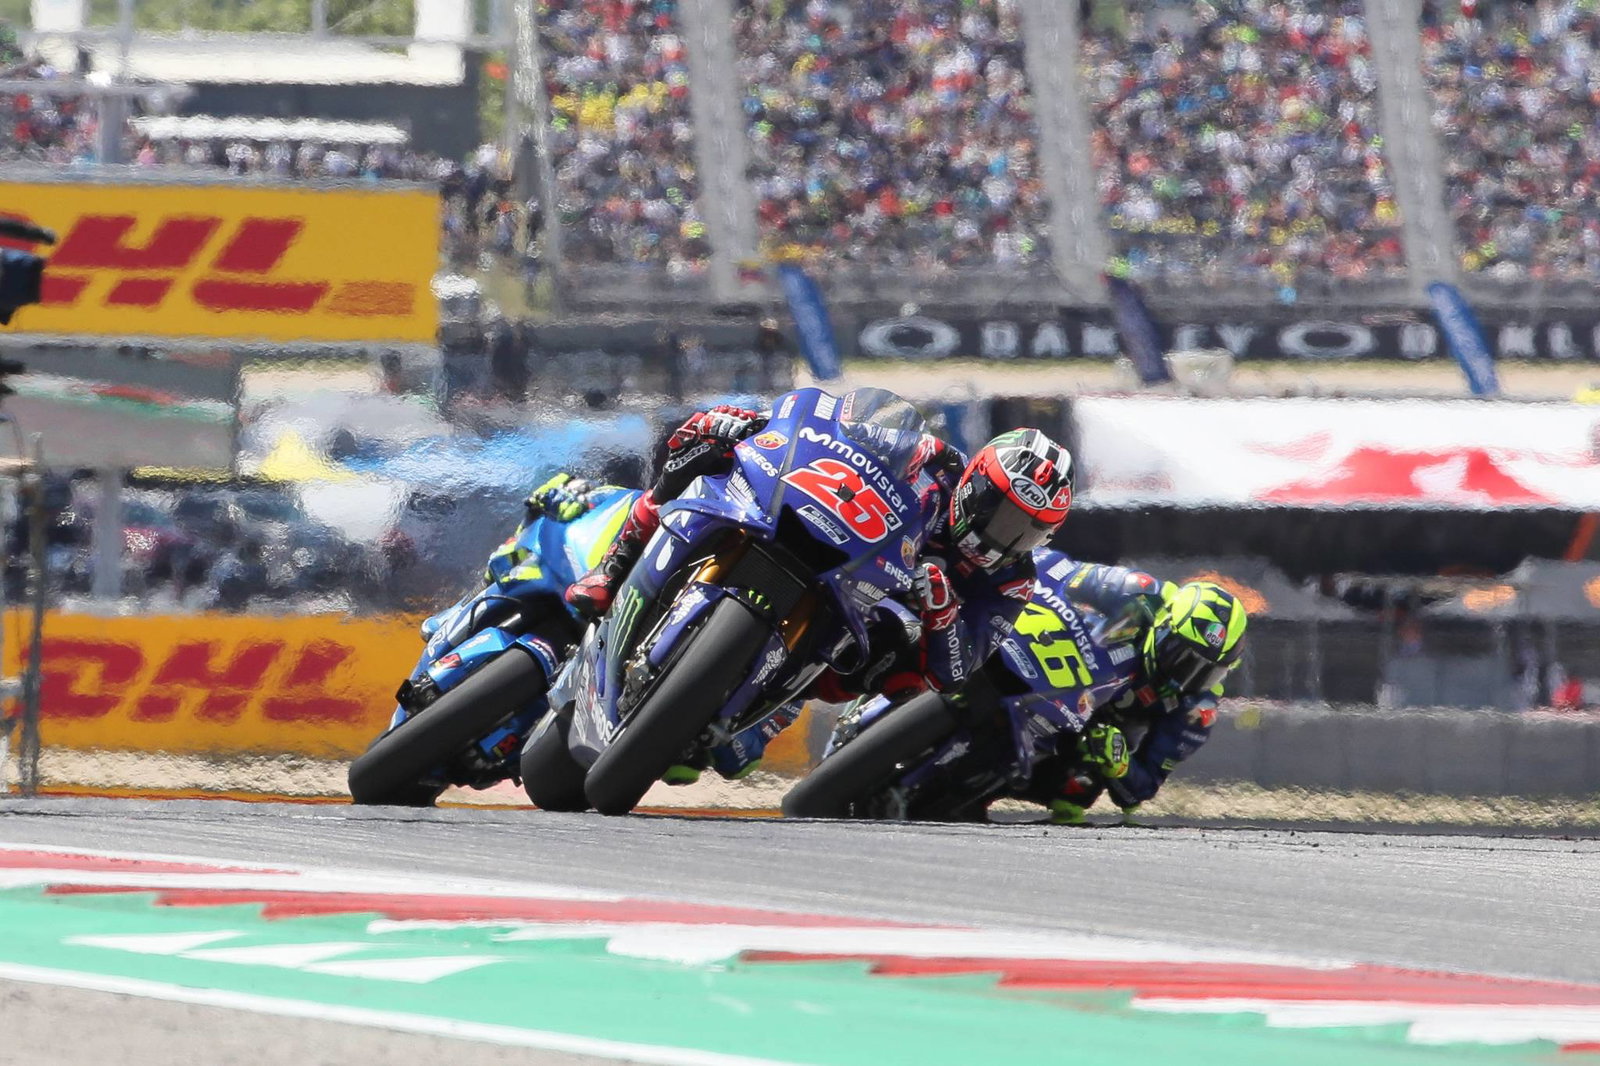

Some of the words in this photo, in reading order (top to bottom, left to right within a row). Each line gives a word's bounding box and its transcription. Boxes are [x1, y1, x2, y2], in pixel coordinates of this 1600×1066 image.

[0, 211, 332, 313] HL
[980, 319, 1257, 358] OAKEY
[1400, 320, 1600, 360] OKL
[741, 445, 779, 477] ENEOS
[828, 440, 908, 513] movistar
[780, 458, 903, 543] 25
[1012, 481, 1045, 505] Arai
[883, 561, 913, 590] ENEOS
[946, 623, 965, 682] movitar
[1046, 595, 1099, 671] movistar
[12, 637, 366, 725] DHL
[1060, 703, 1083, 733] ENEOS
